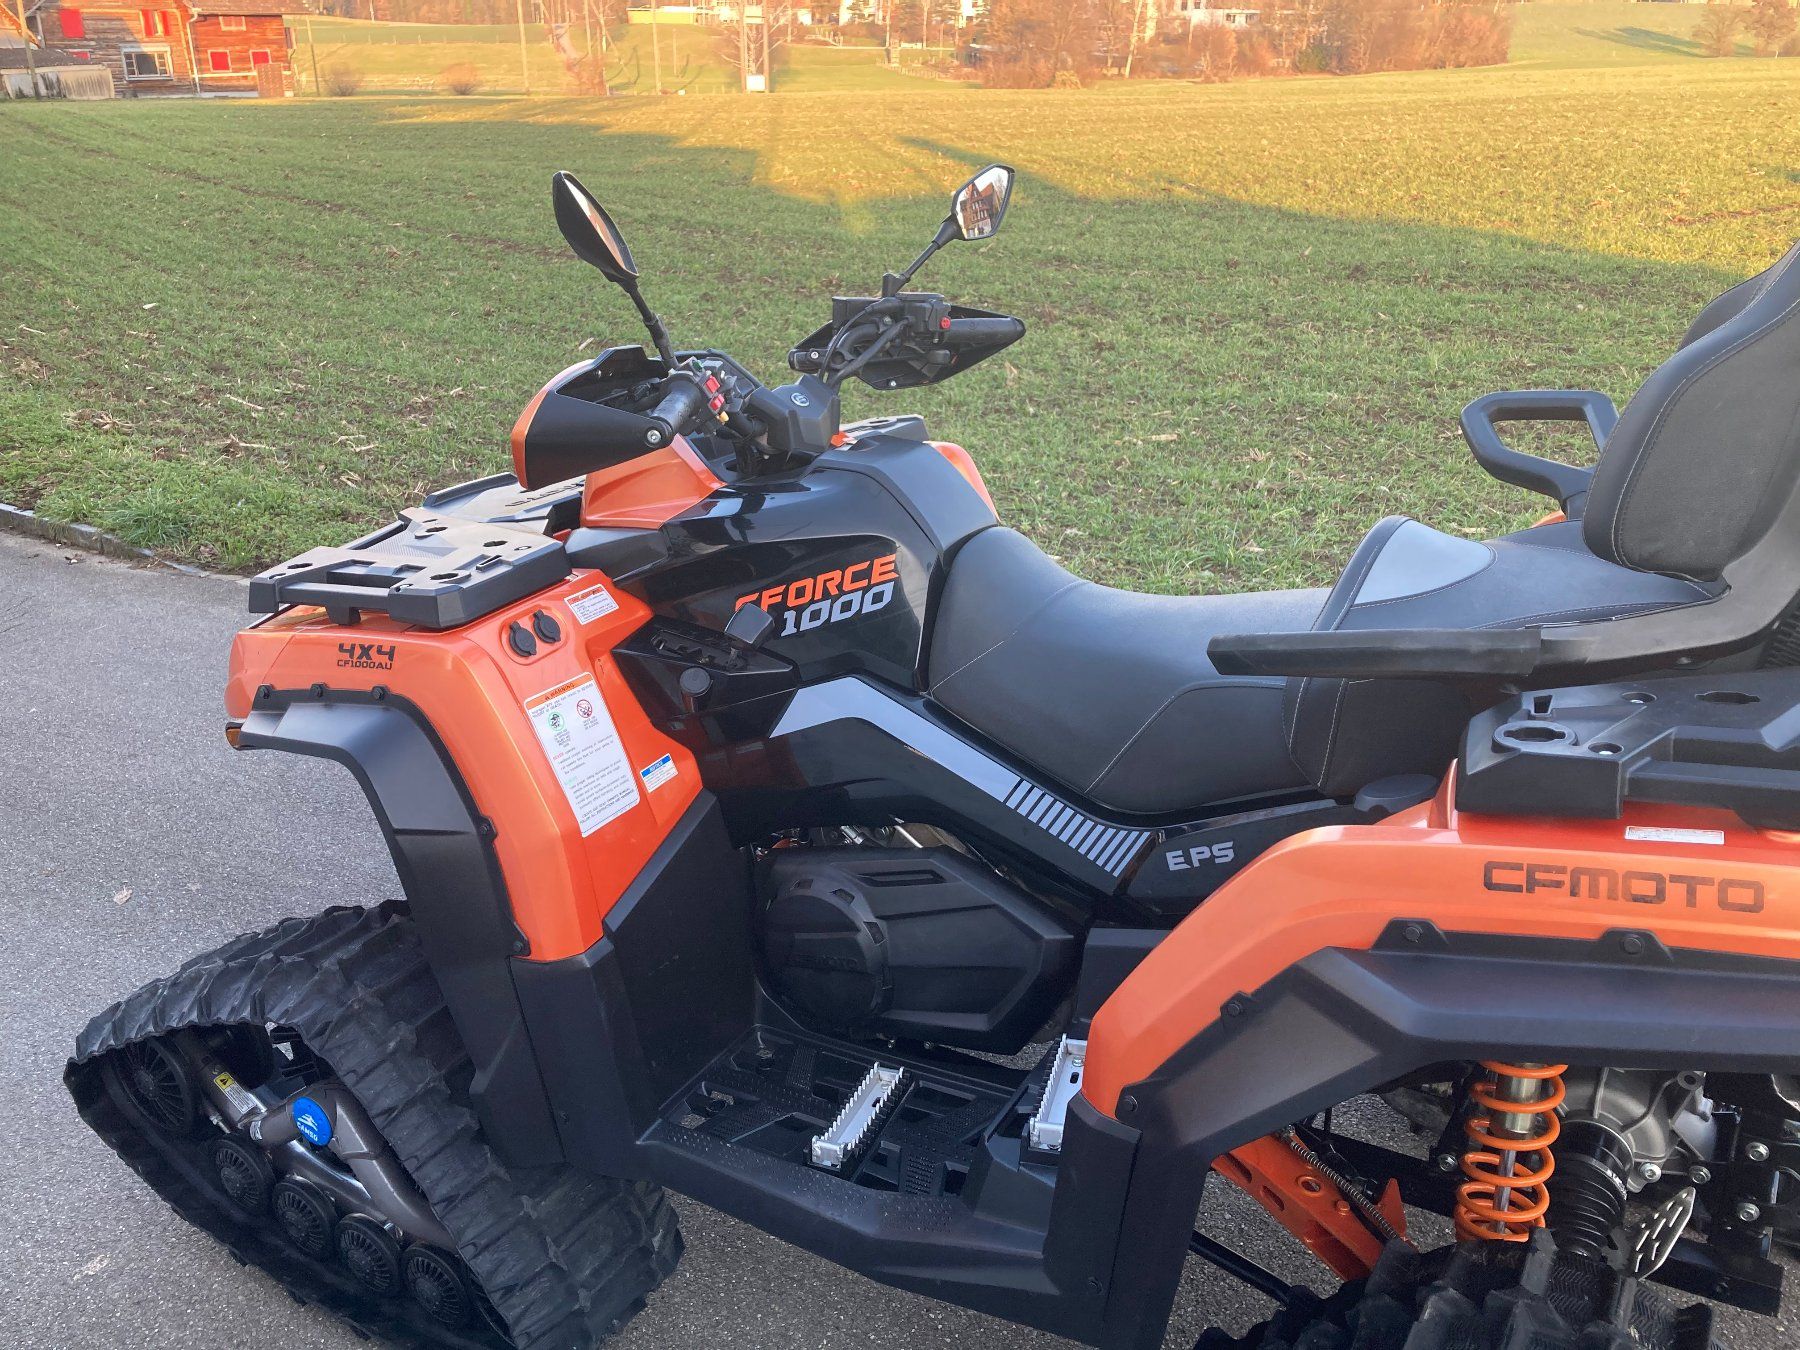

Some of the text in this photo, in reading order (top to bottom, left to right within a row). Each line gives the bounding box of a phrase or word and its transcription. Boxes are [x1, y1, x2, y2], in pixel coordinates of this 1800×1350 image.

[780, 581, 894, 637] 1000
[338, 643, 396, 663] 4X4
[1166, 841, 1235, 871] EPS
[1483, 860, 1765, 914] CFMOTO
